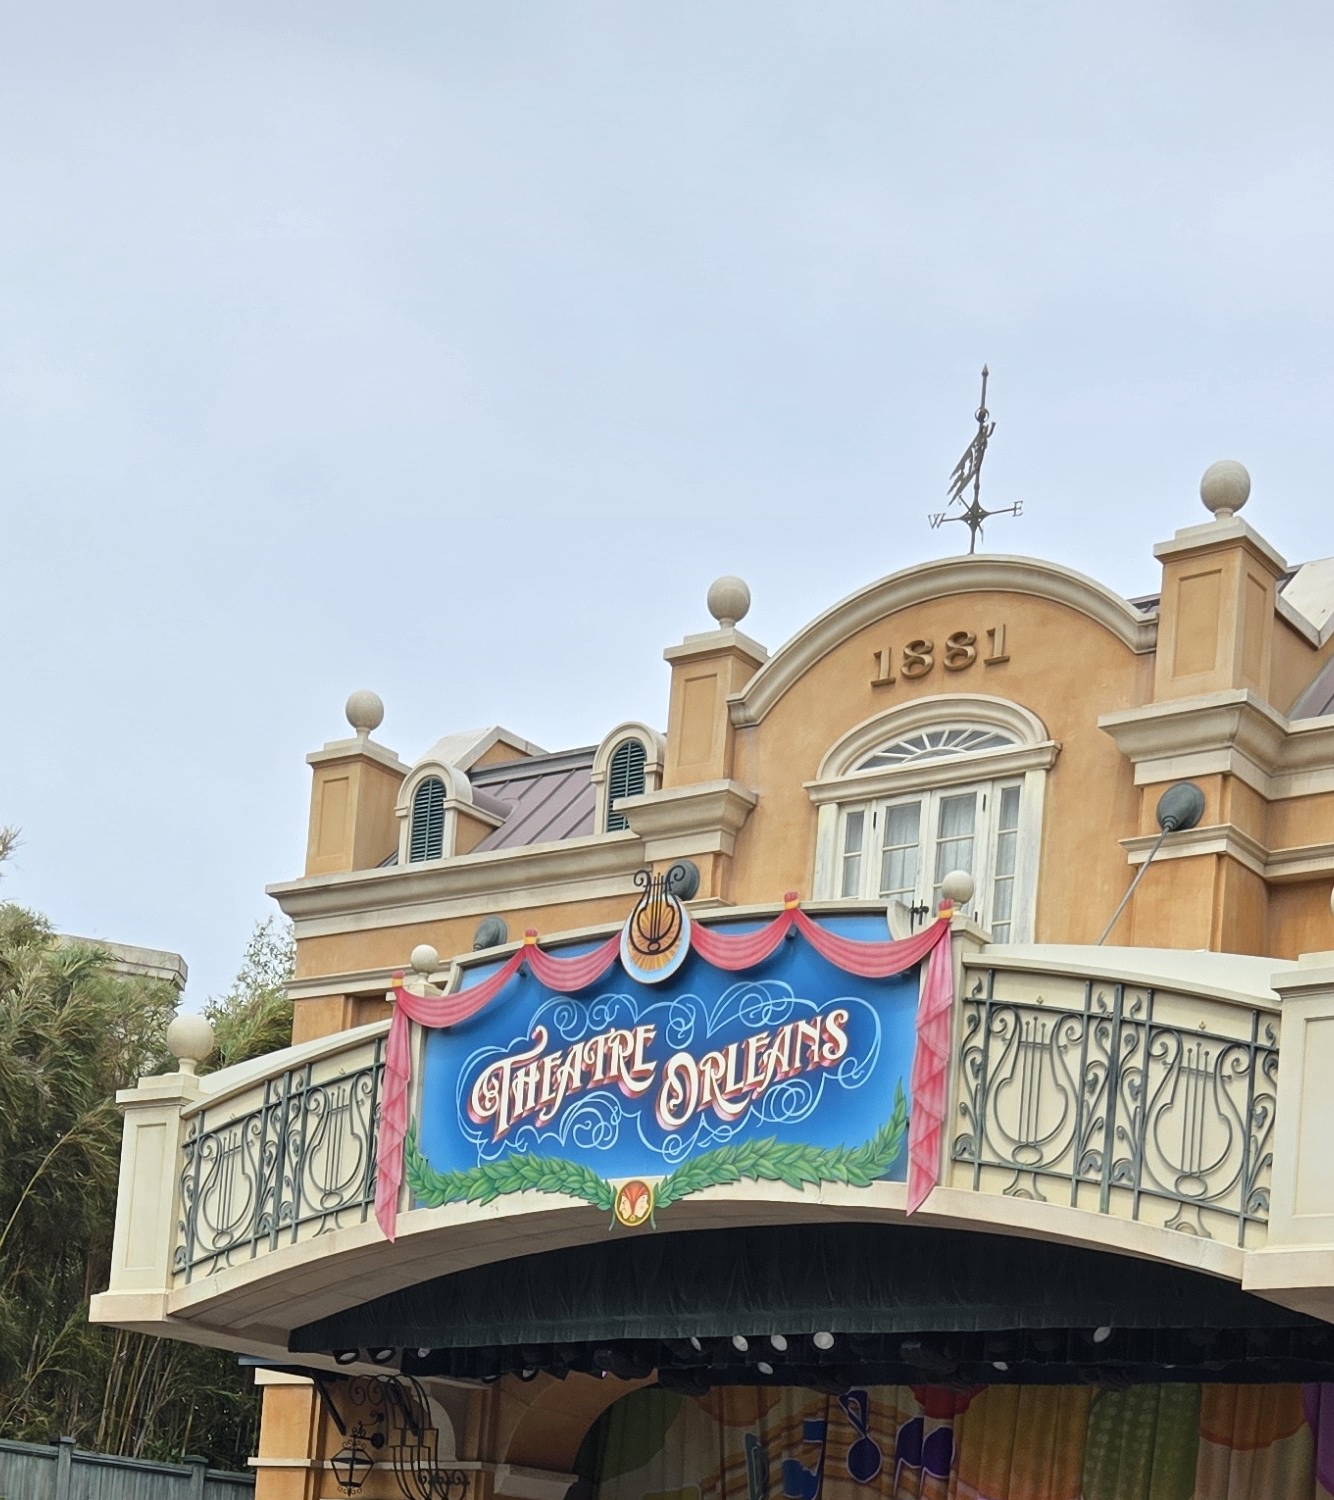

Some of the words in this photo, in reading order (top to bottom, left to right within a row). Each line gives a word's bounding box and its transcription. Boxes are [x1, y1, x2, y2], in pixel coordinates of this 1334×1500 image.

[871, 624, 1011, 687] 1881
[469, 1025, 657, 1141] THEATRE
[657, 1009, 850, 1130] ORLEANS
